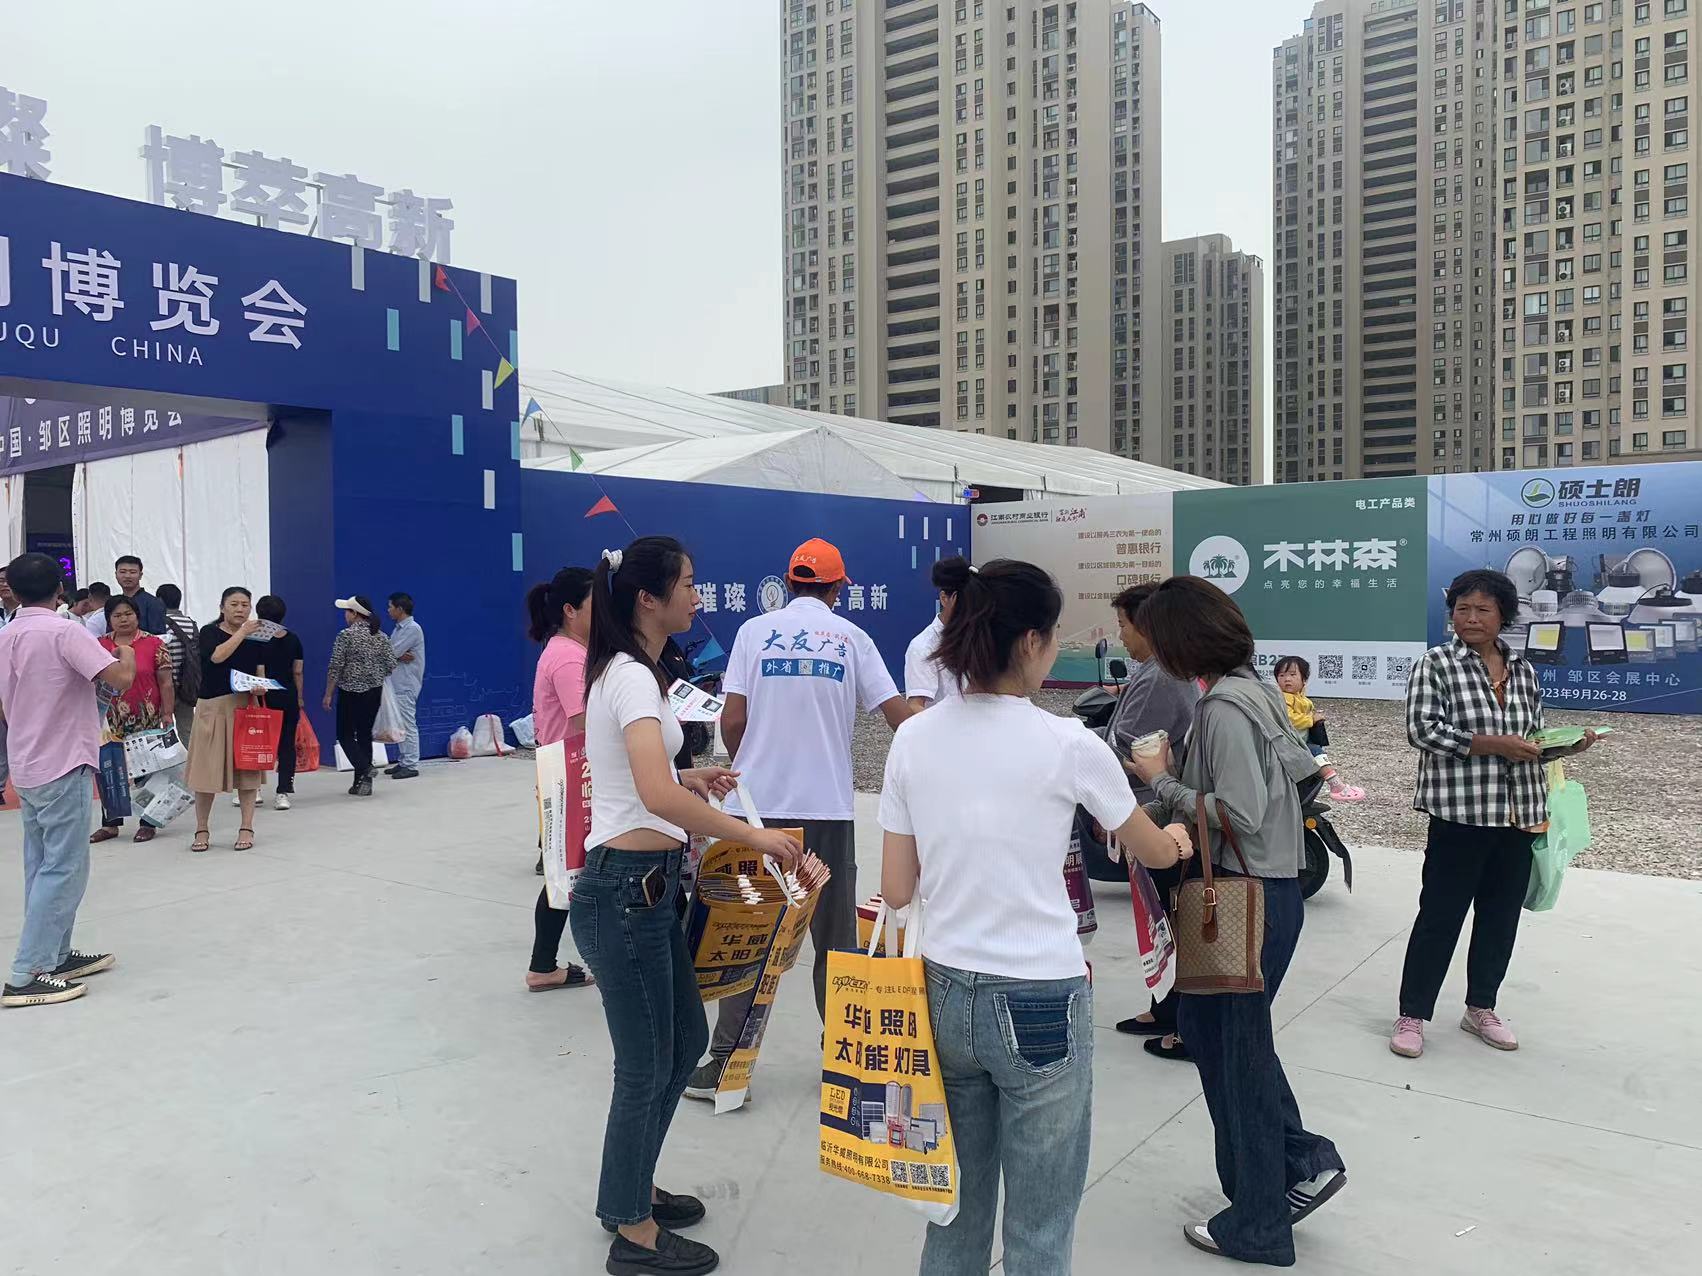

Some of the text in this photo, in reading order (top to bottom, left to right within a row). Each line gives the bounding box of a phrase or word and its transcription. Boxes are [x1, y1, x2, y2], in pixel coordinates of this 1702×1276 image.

[138, 124, 454, 264] 博萃高新
[0, 236, 308, 349] 博览会
[111, 336, 203, 366] CHINA
[1557, 477, 1641, 500] 硕士朗
[1355, 497, 1416, 510] 电工产品类
[1558, 499, 1638, 507] SHUOSHILANG
[1511, 510, 1652, 526] 用心做好每一盏灯
[1470, 524, 1700, 543] 常州硕朗工程照明有限公司
[1116, 543, 1161, 554] 普惠银行
[1263, 538, 1397, 572] 木林森
[1264, 578, 1398, 589] 点亮您的幸福生活
[694, 582, 746, 613] 璀璨
[832, 583, 888, 611] 高新
[762, 628, 847, 657] 大友广告
[766, 660, 842, 677] 外省 推广
[1567, 669, 1681, 686] 邹区会展中心
[820, 1140, 889, 1171] 临沂华威照明有限公司
